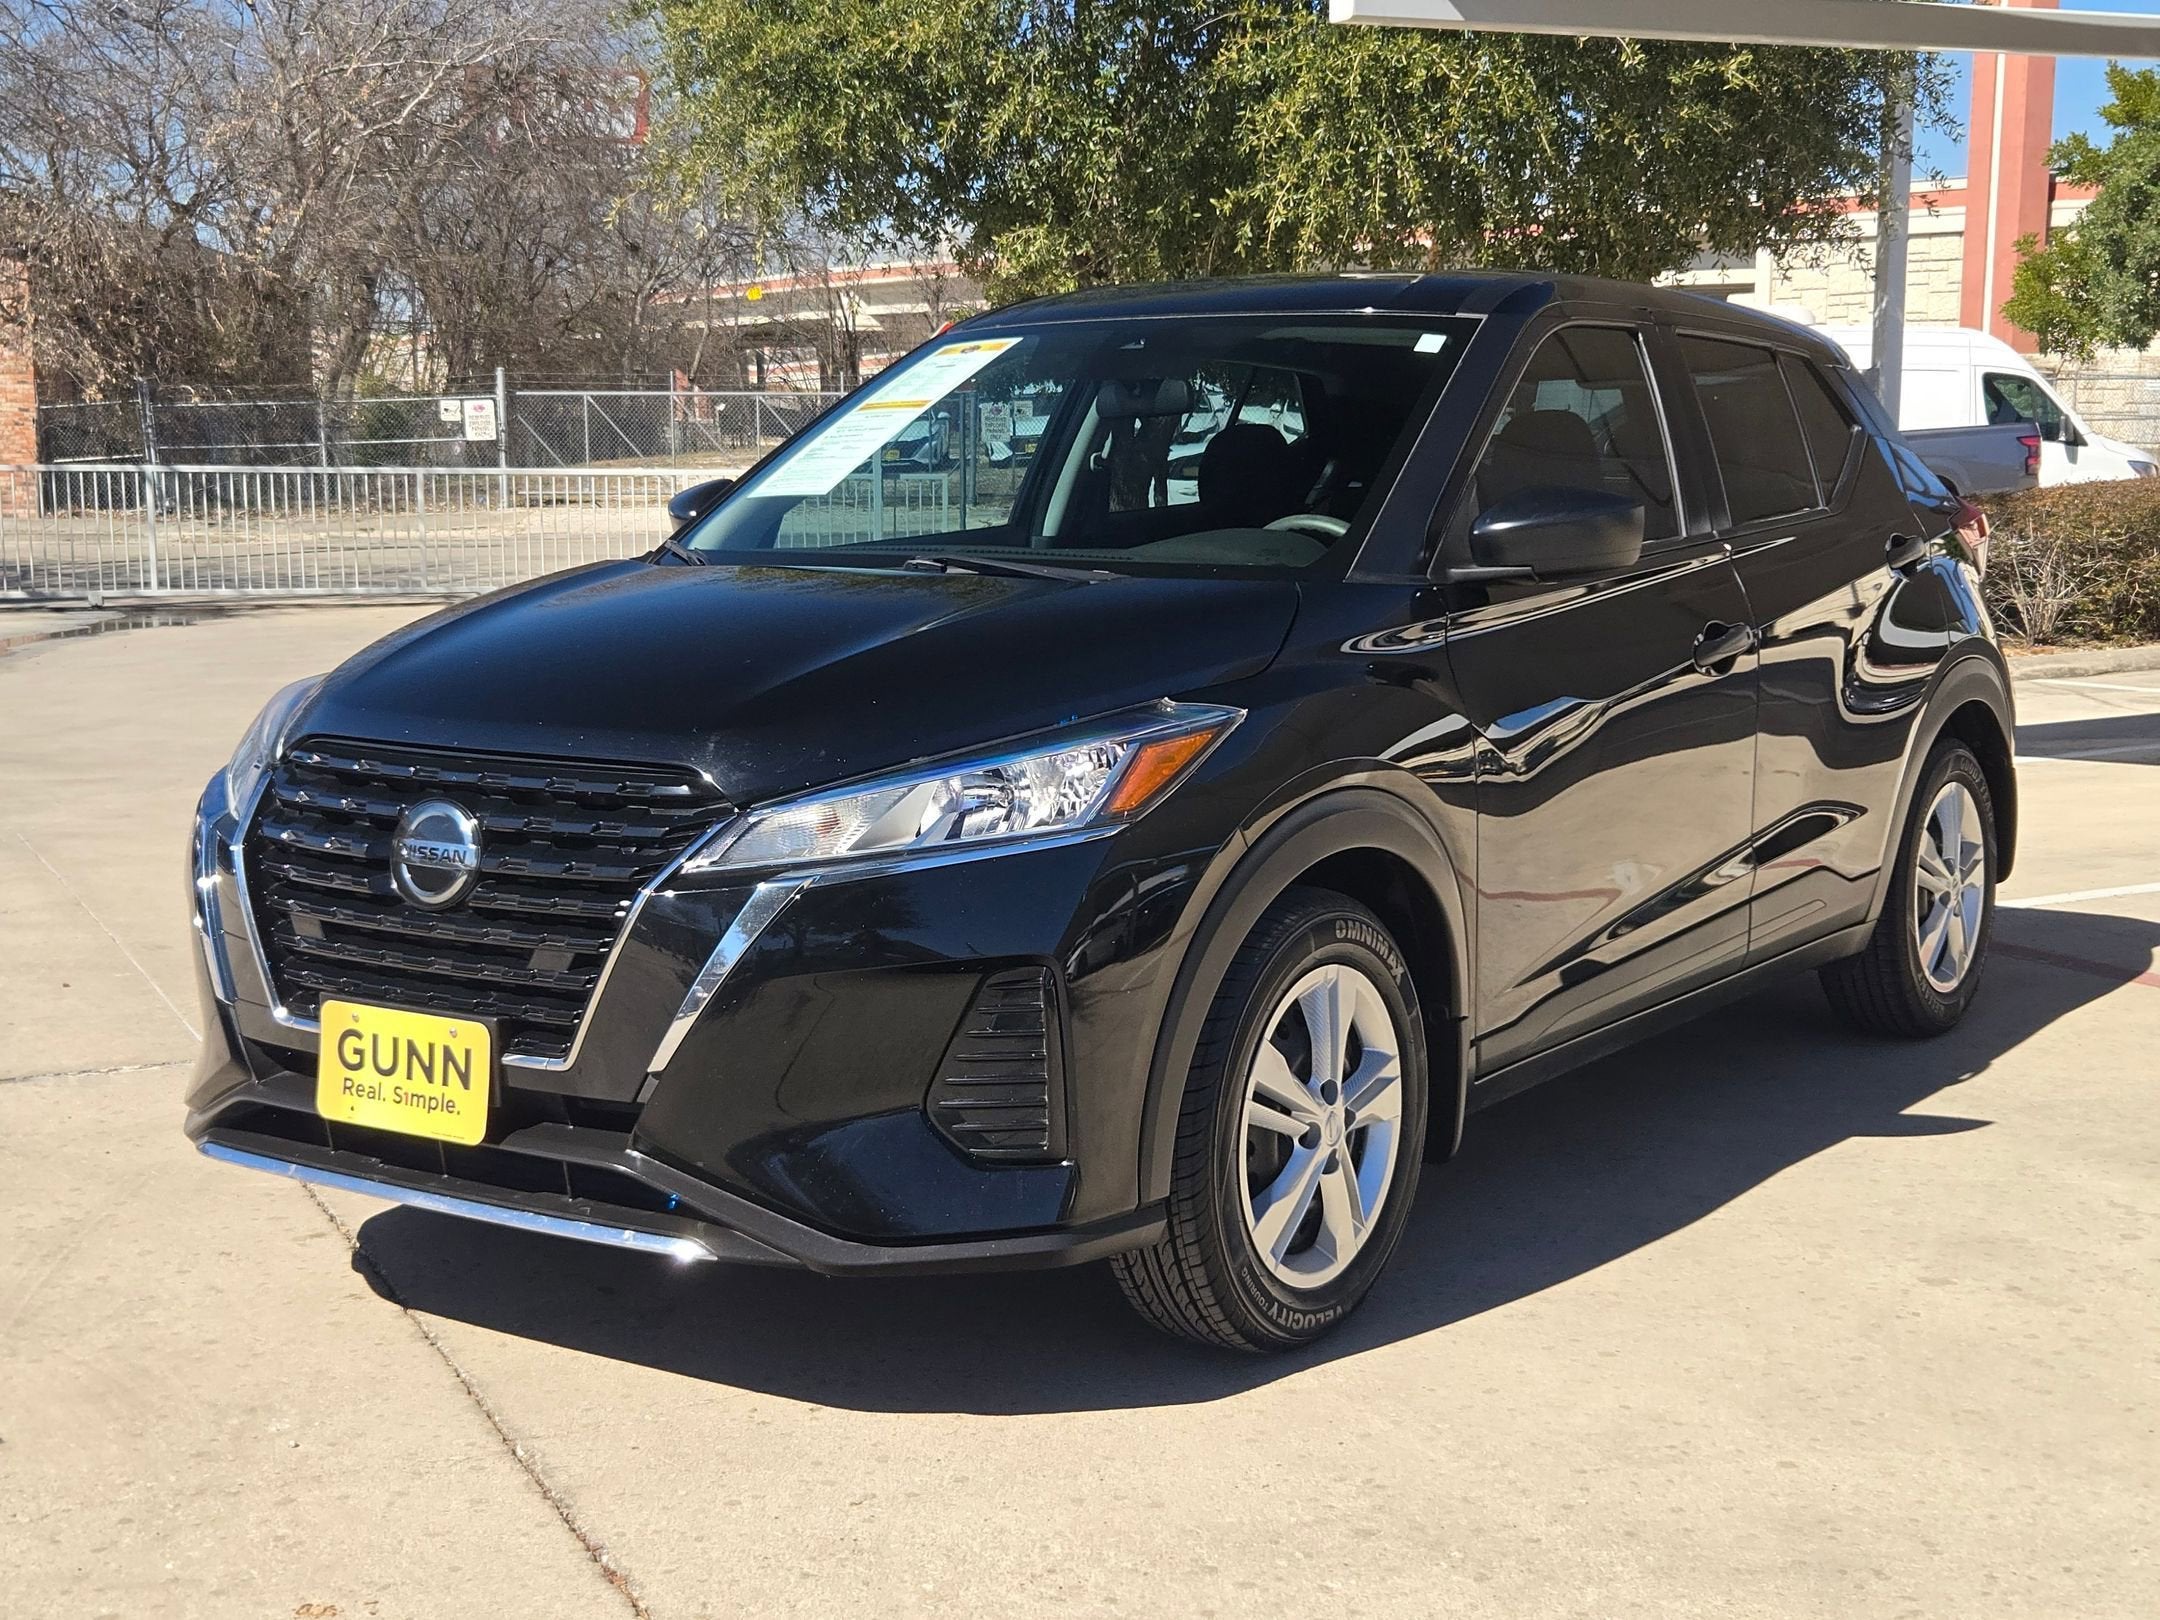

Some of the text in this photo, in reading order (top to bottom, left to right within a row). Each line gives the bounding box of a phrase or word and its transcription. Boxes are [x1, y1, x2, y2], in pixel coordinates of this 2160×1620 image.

[1335, 919, 1405, 986] OMNIMAX
[337, 1028, 473, 1091] GUNN
[342, 1077, 387, 1102] Real.
[1241, 1267, 1343, 1330] VELOCITY TOURING
